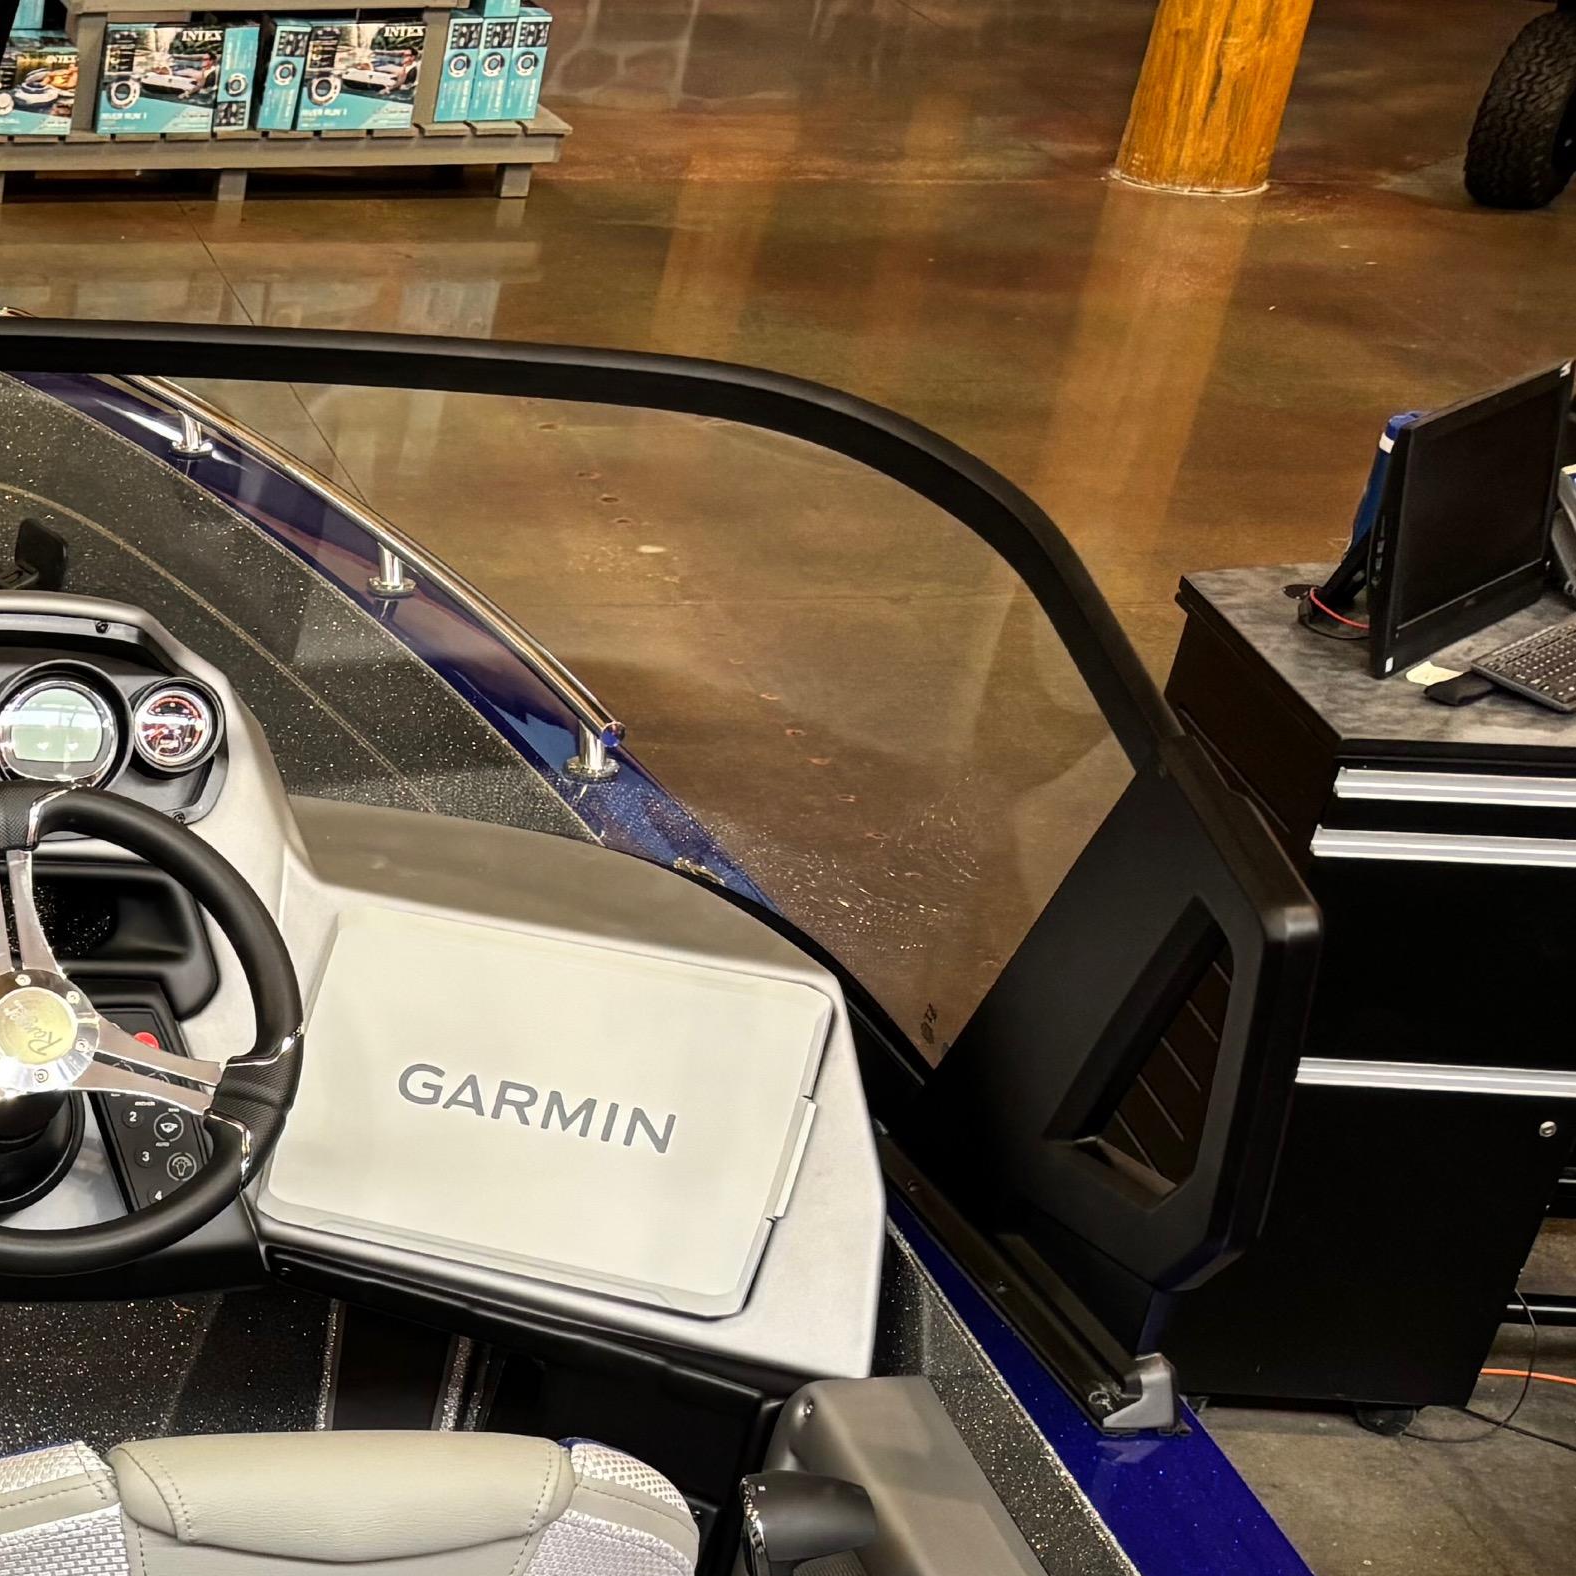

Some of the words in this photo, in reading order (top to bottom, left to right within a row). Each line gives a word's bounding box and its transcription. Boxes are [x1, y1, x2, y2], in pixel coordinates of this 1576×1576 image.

[182, 30, 224, 41] INTEX
[384, 26, 426, 37] INTEX
[398, 1063, 677, 1154] GARMIN
[129, 1111, 137, 1122] 2
[142, 1151, 150, 1162] 3
[154, 1190, 163, 1201] 4
